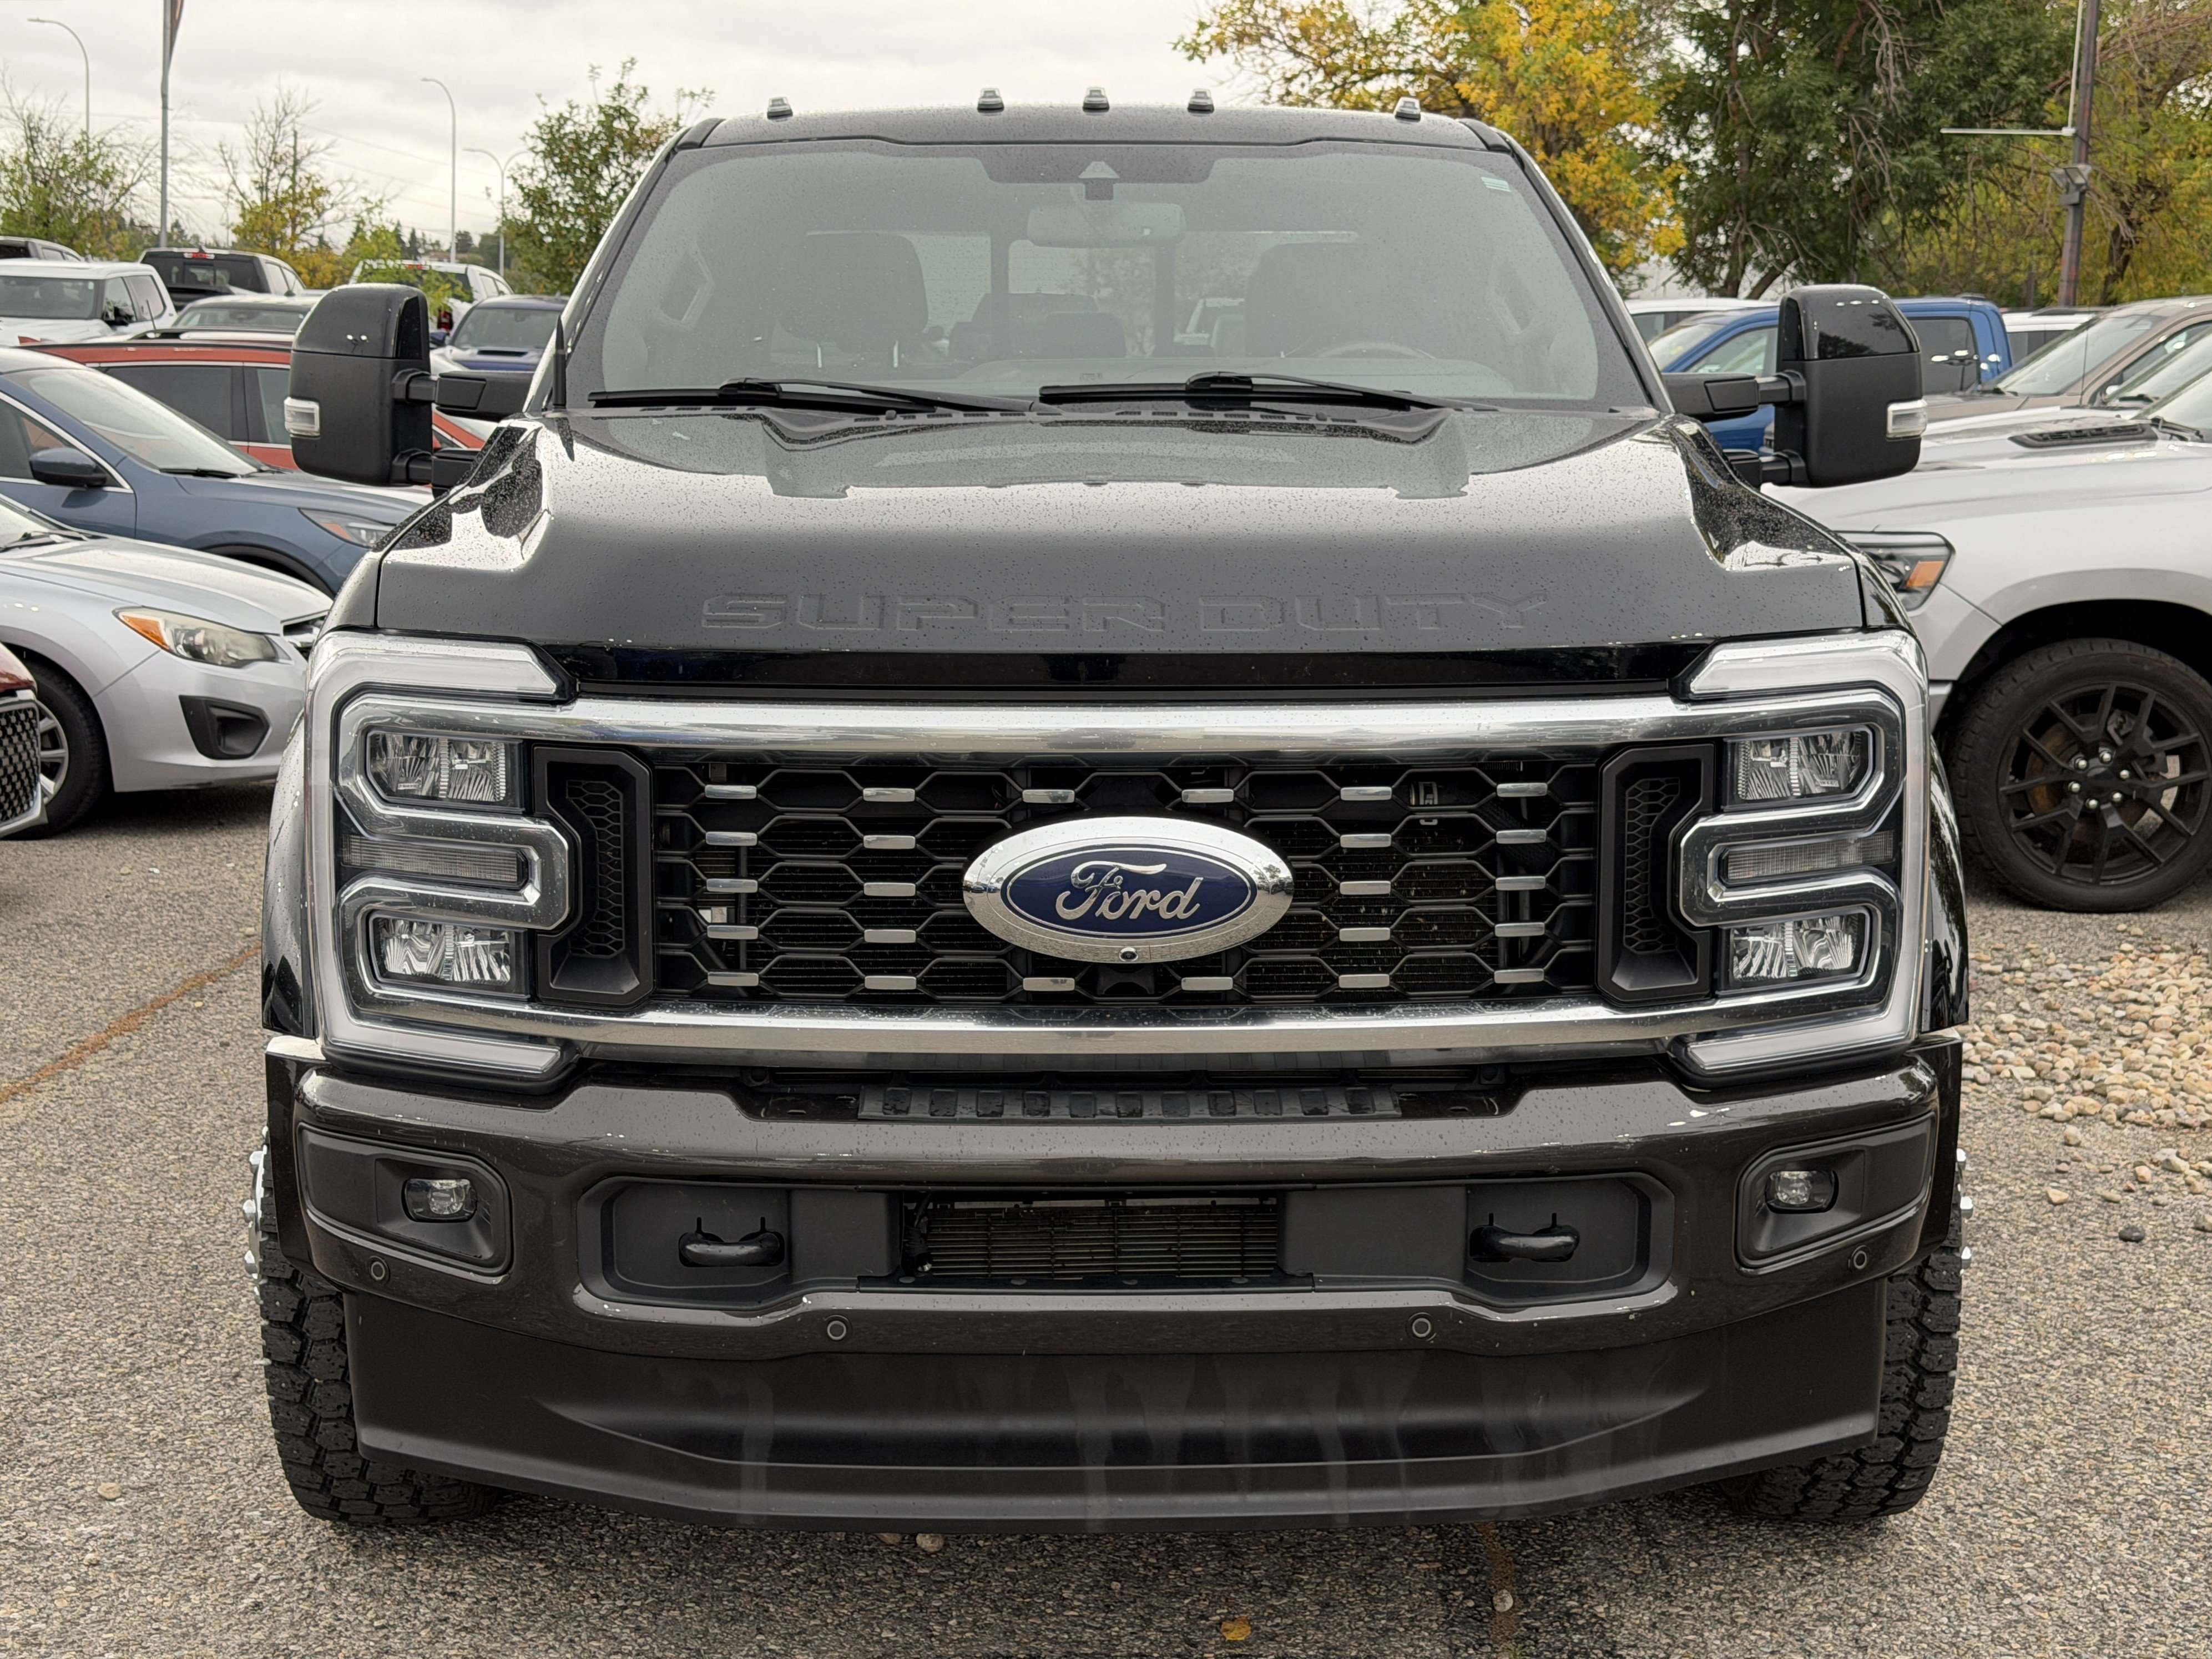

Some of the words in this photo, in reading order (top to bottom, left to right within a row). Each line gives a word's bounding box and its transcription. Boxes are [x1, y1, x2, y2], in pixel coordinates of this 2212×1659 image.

[701, 594, 1165, 631] SUPER
[1199, 591, 1548, 631] DUTY
[1055, 861, 1204, 920] Ford
